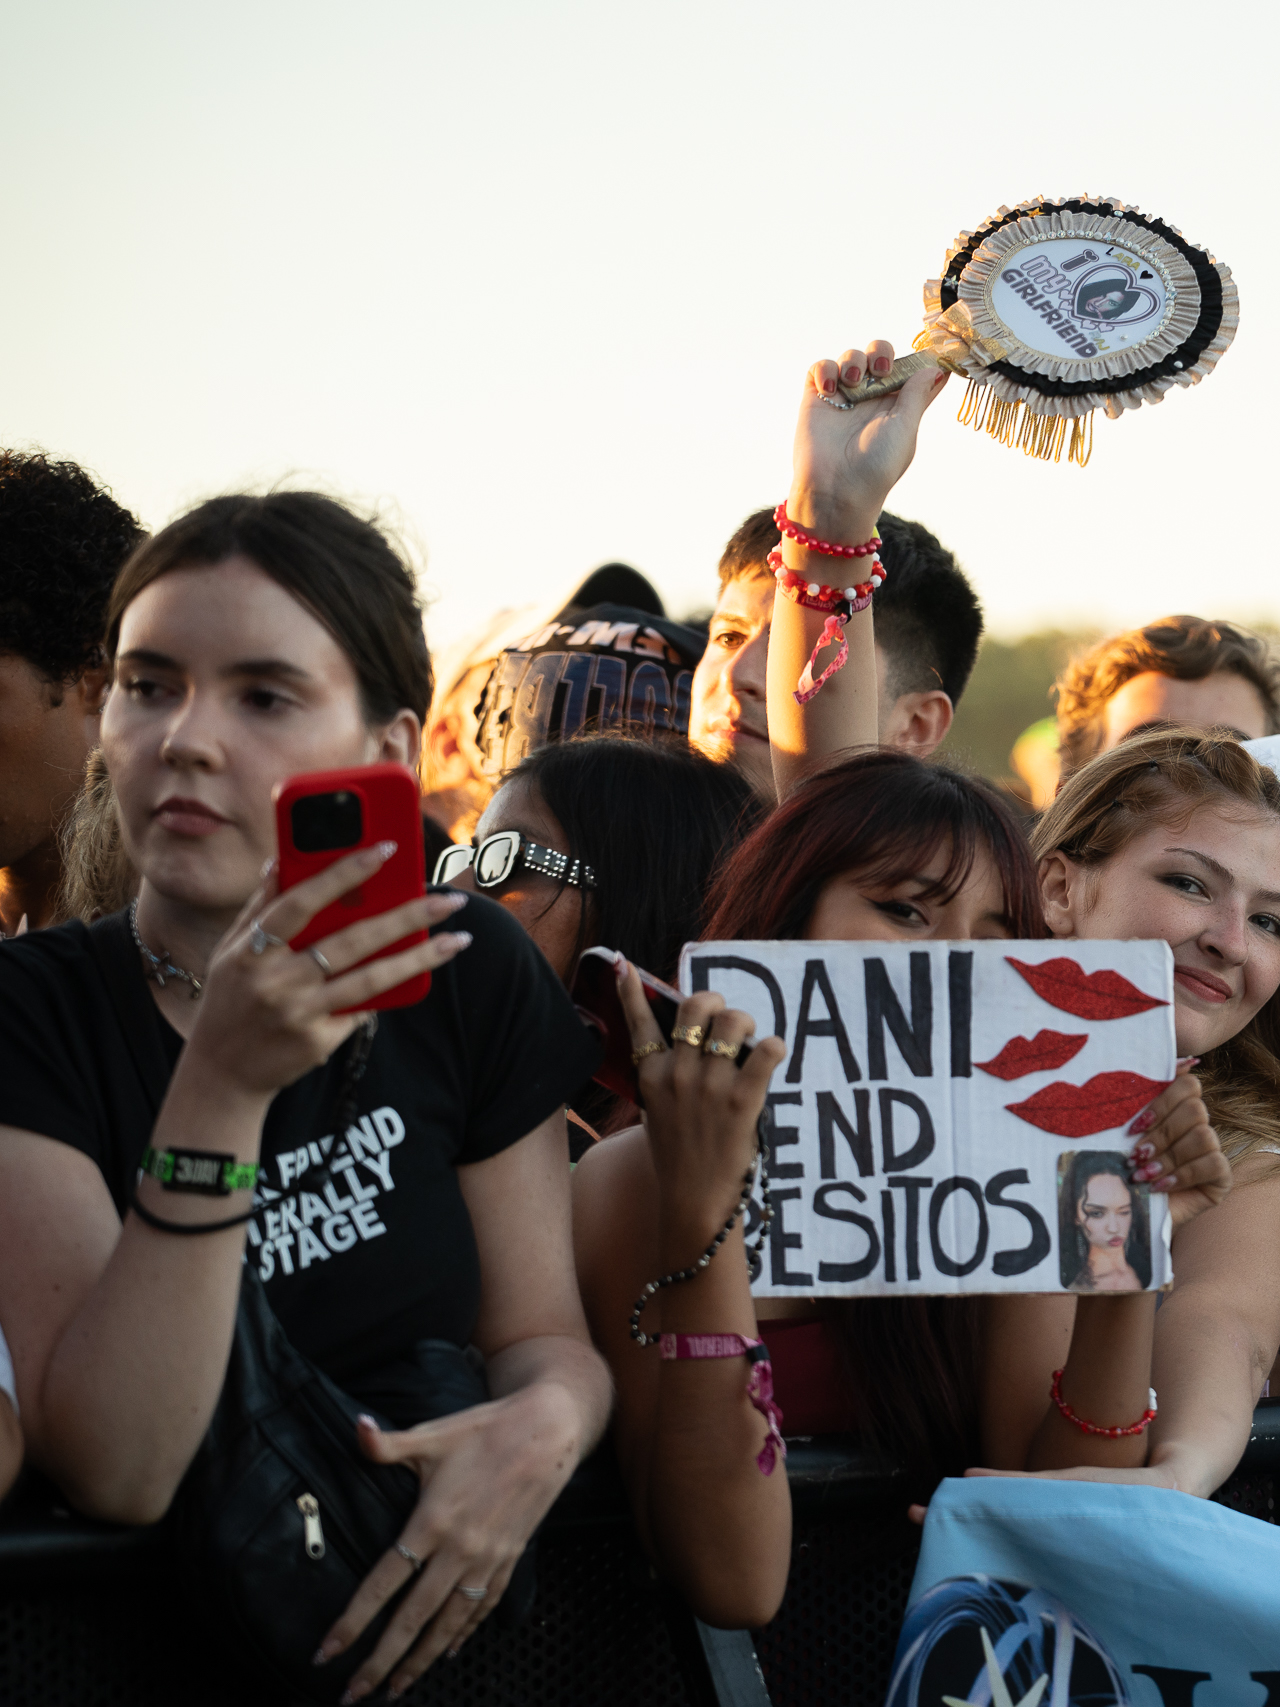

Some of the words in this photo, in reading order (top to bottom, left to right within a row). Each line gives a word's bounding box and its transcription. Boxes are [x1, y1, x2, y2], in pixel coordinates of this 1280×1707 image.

[1106, 247, 1141, 271] LARA
[691, 950, 973, 1083] DANI
[764, 1087, 936, 1179] END
[258, 1200, 387, 1283] STAGE
